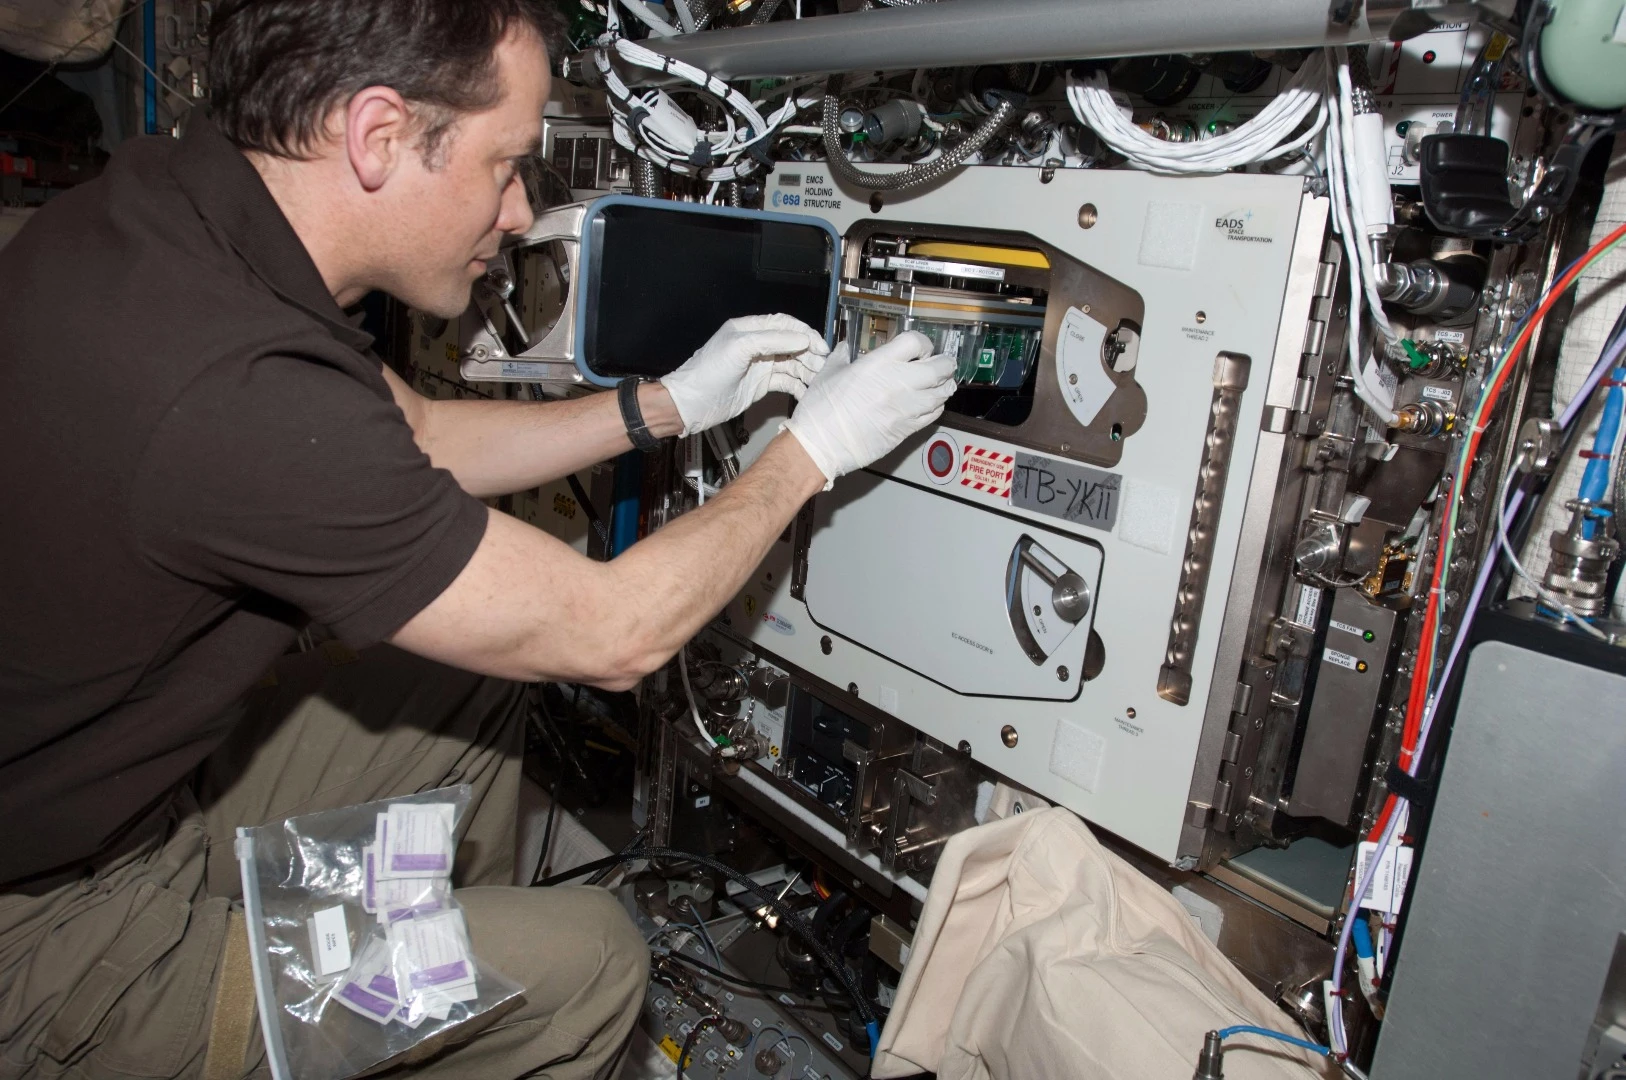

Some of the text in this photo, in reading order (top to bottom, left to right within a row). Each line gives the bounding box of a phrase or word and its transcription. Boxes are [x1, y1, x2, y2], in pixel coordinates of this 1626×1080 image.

[1391, 166, 1404, 175] J2
[806, 175, 824, 184] EMCS
[804, 187, 833, 197] HOLDING
[782, 194, 800, 206] esa
[803, 199, 842, 209] STRUCTURE
[1215, 218, 1244, 229] EADS
[1227, 235, 1273, 243] TRANSPORTATION
[1181, 326, 1215, 336] MAINTENANCE
[971, 457, 996, 468] EMERGENCY
[969, 464, 1005, 480] FIRE PORT
[1039, 618, 1047, 634] OPEN
[1336, 622, 1357, 633] TCS FAN
[958, 635, 976, 647] ACCESS
[976, 643, 989, 652] DOOR
[1330, 650, 1351, 660] SPONGE
[1328, 656, 1350, 667] REPLACE
